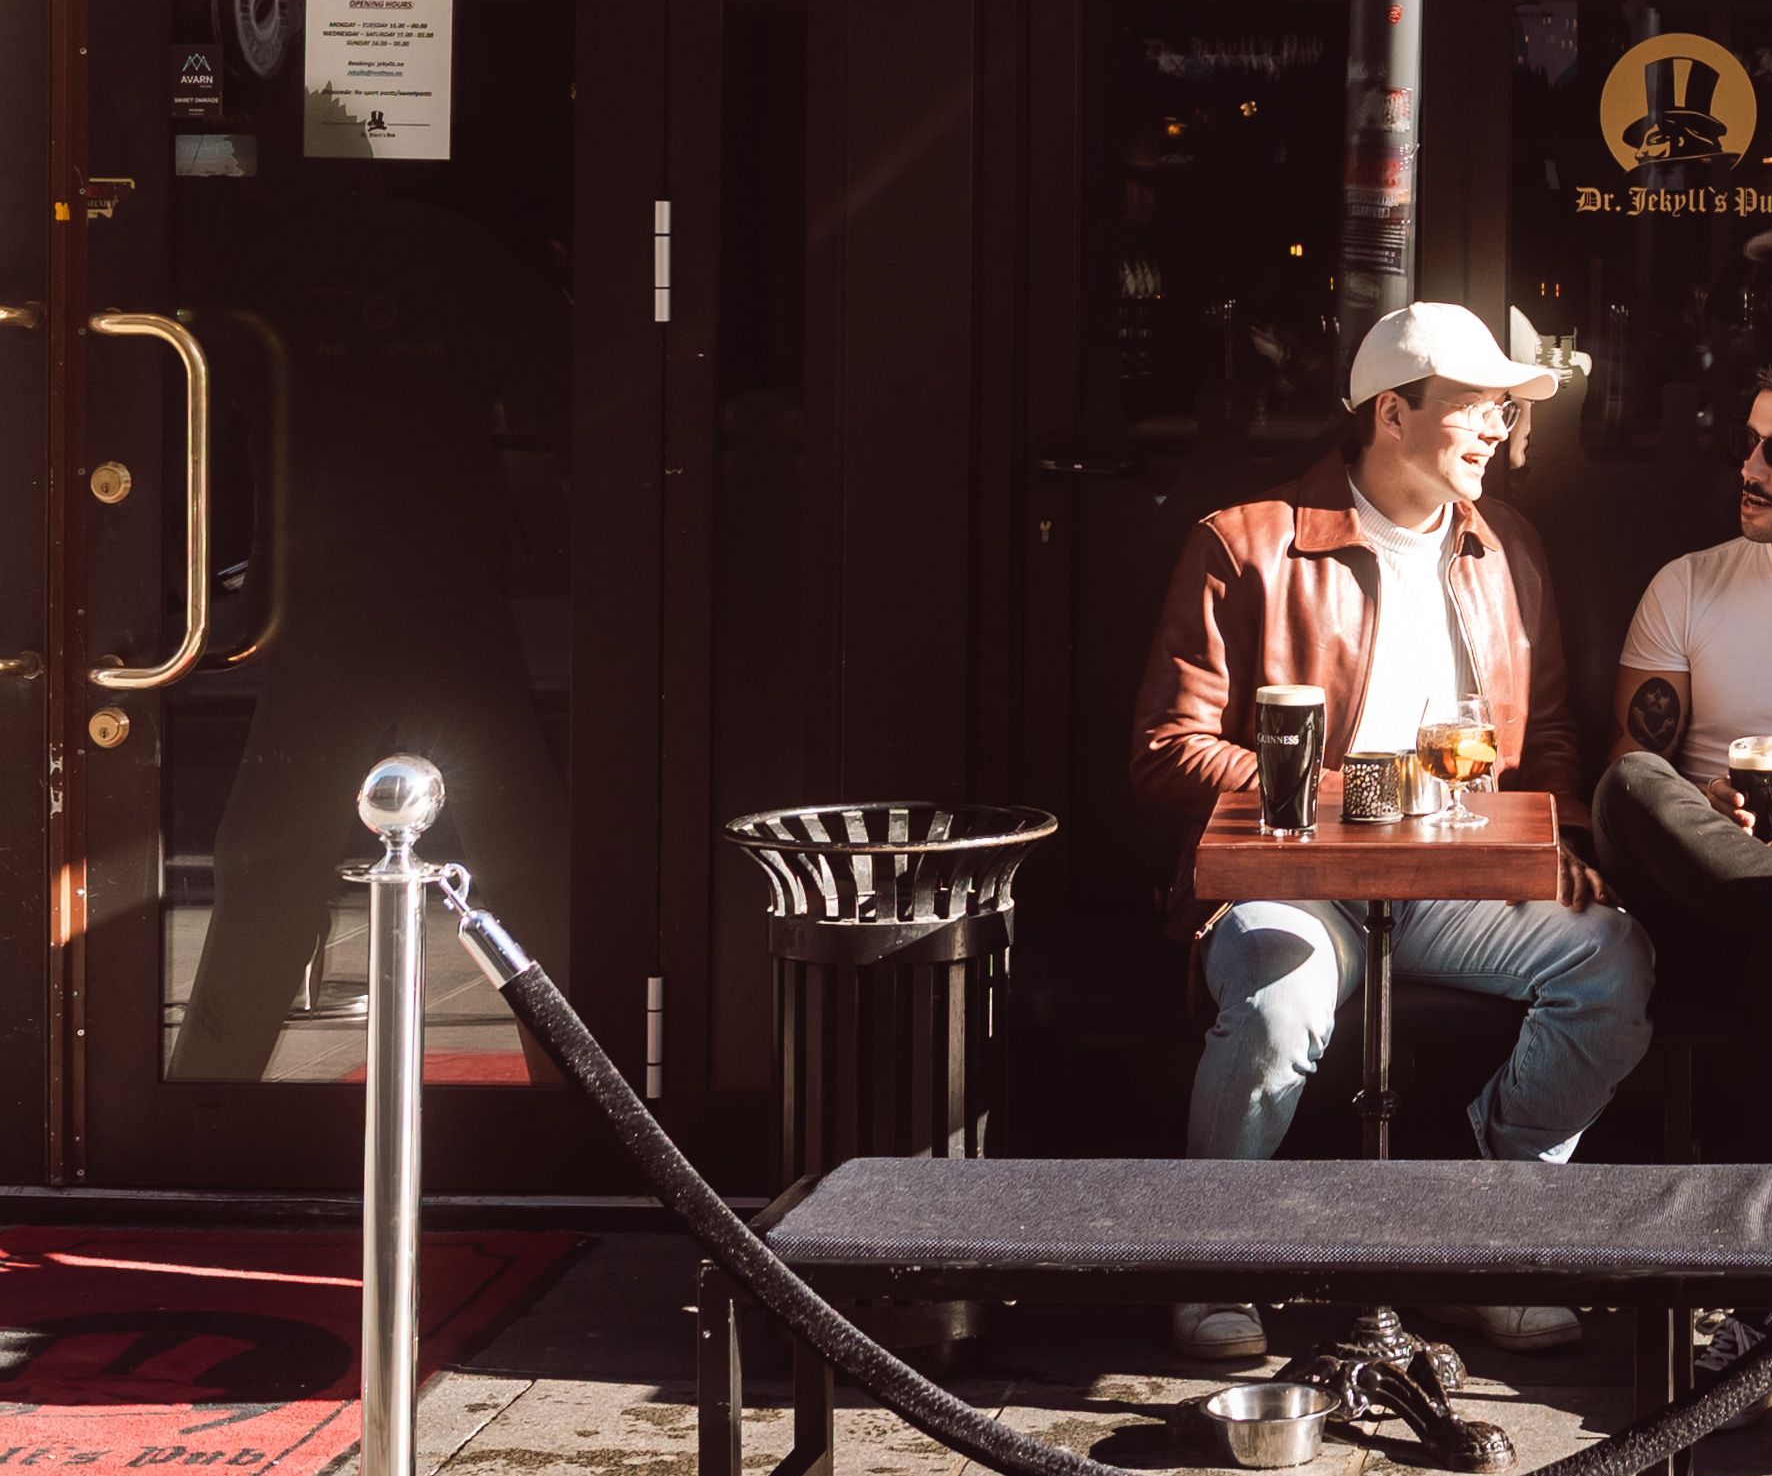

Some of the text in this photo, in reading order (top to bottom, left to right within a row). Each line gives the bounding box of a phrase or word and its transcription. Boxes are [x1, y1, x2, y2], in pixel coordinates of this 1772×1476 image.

[349, 0, 384, 9] OPENING
[180, 75, 214, 84] AVARN
[1576, 186, 1622, 213] Dr.
[1257, 732, 1299, 745] GUINNESS
[125, 1445, 266, 1468] Pub
